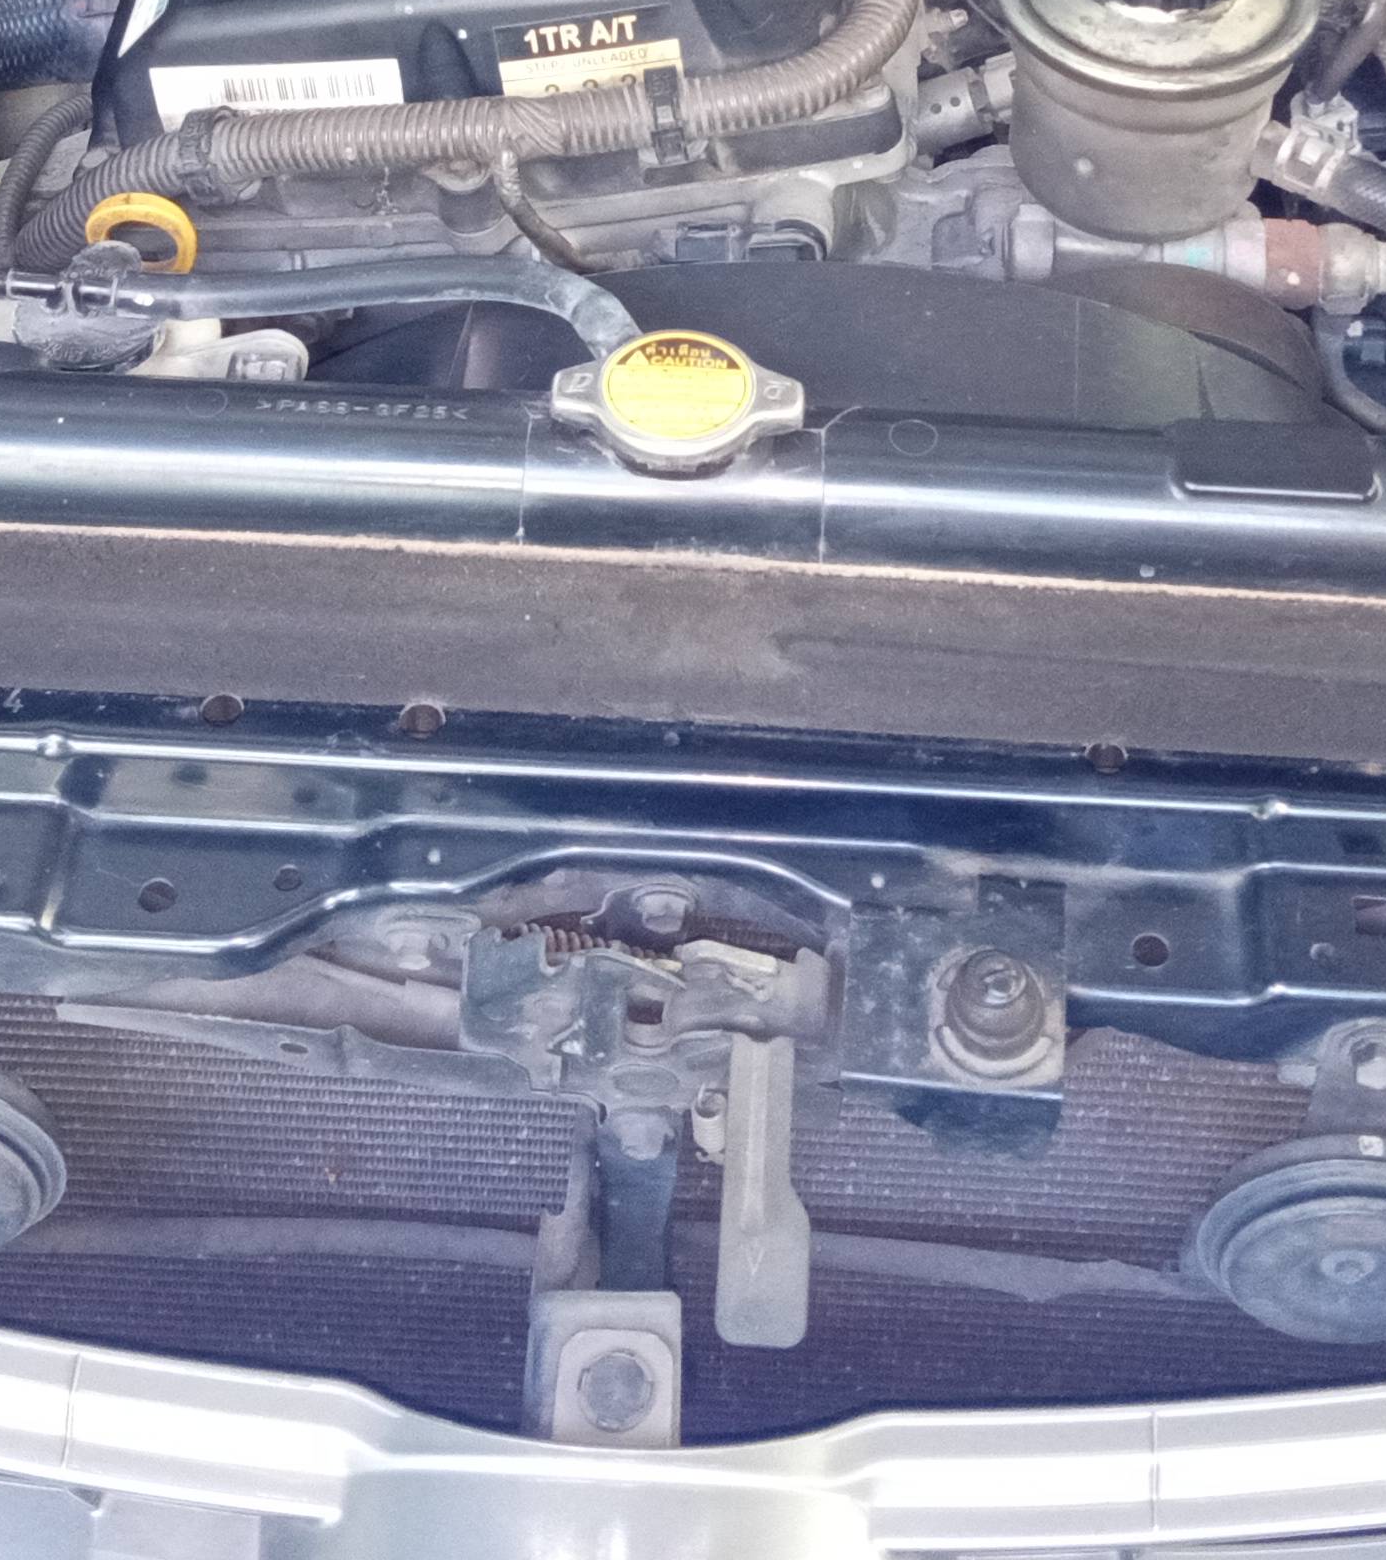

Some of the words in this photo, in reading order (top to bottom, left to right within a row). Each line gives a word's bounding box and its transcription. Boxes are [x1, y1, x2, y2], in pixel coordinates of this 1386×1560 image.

[524, 24, 581, 54] 1TR
[590, 15, 637, 46] A/T
[649, 356, 728, 369] CAUTION
